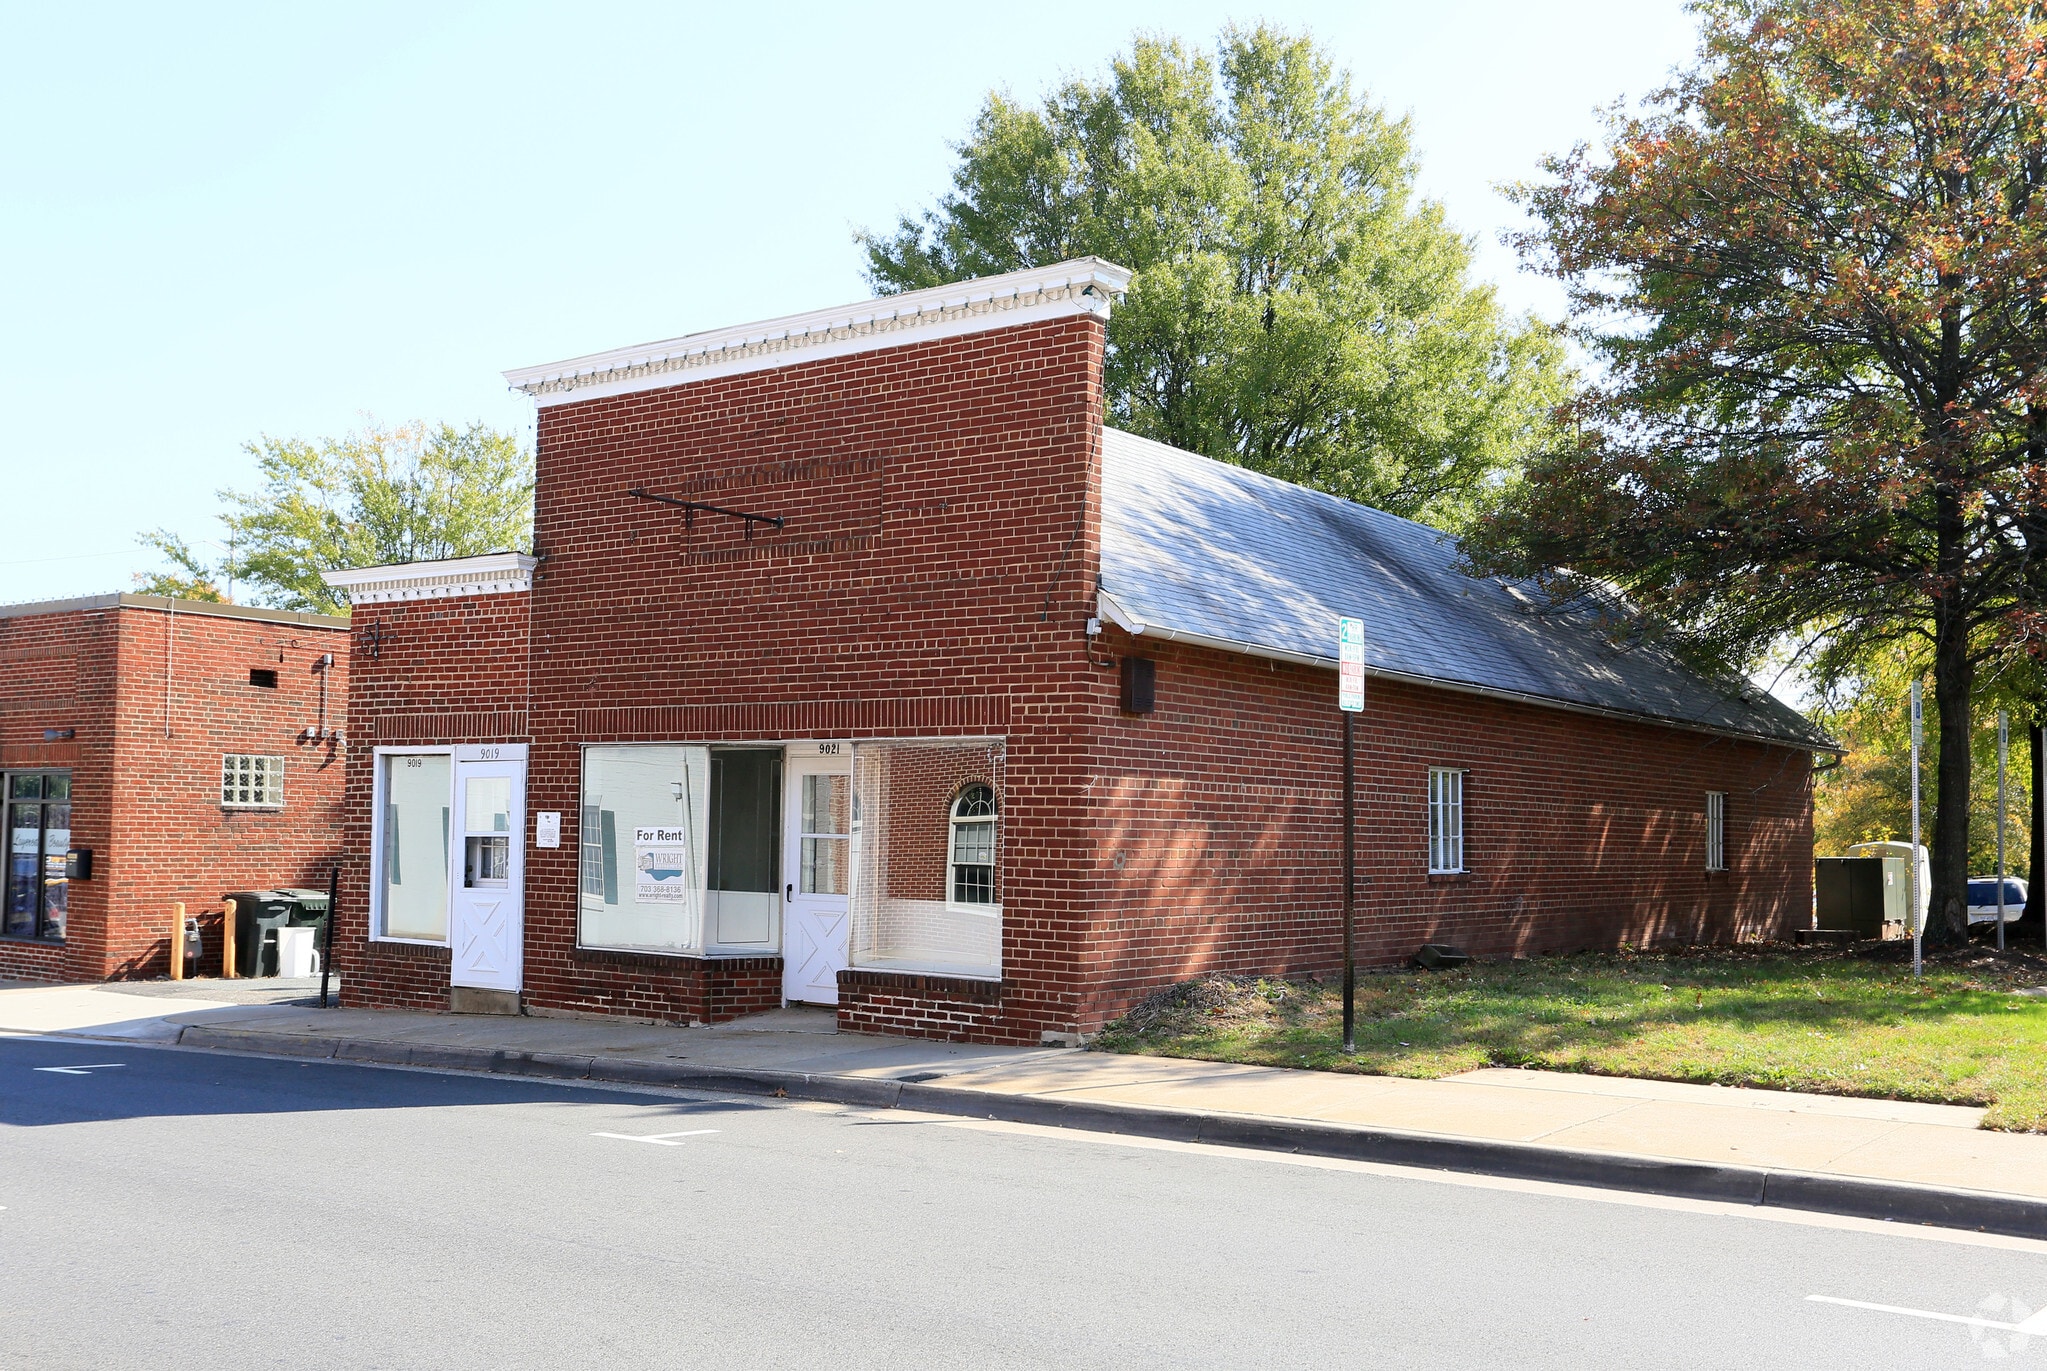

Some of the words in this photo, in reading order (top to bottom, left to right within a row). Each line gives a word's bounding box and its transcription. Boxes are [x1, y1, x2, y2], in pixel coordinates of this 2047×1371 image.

[480, 748, 500, 759] 9019
[819, 744, 840, 754] 9021
[407, 758, 422, 767] 9019
[637, 830, 654, 840] For
[657, 830, 682, 840] Rent
[655, 852, 683, 863] WRIGHT
[640, 885, 652, 893] 703
